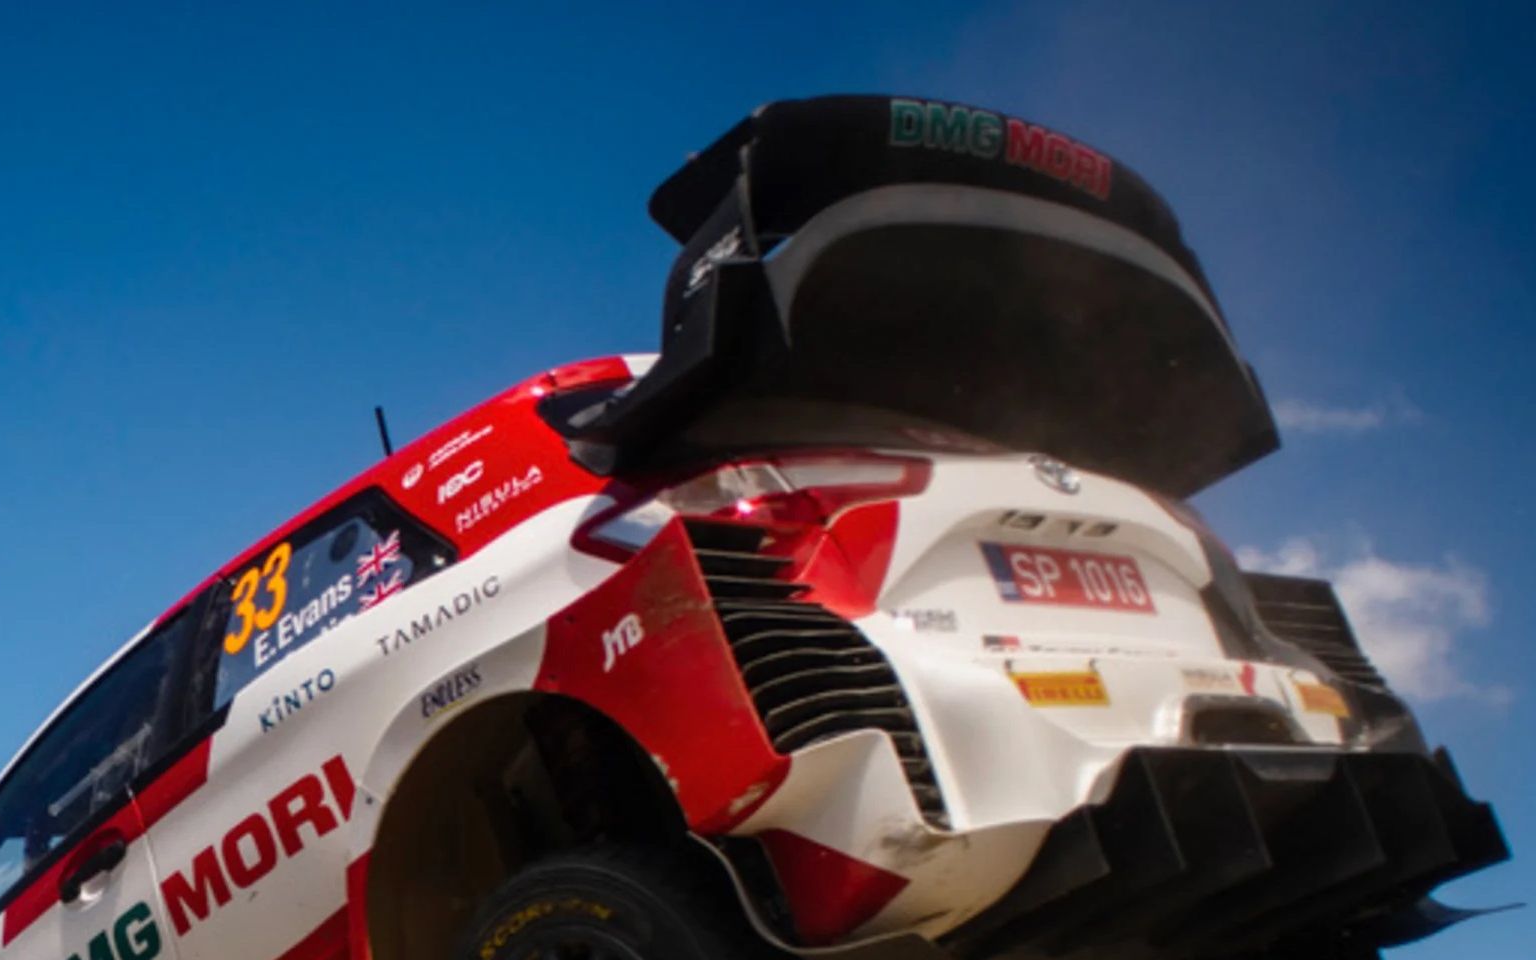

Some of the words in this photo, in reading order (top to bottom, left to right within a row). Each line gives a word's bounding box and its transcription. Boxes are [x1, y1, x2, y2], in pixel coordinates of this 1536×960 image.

[889, 97, 1002, 159] DMG
[1006, 118, 1113, 201] MORI
[223, 541, 293, 655] 33
[375, 575, 501, 656] TAMADIC
[1009, 551, 1061, 598] SP
[1068, 557, 1148, 607] 1016
[601, 612, 645, 674] JTB
[421, 662, 483, 719] ENDLESS
[159, 754, 356, 938] MORI
